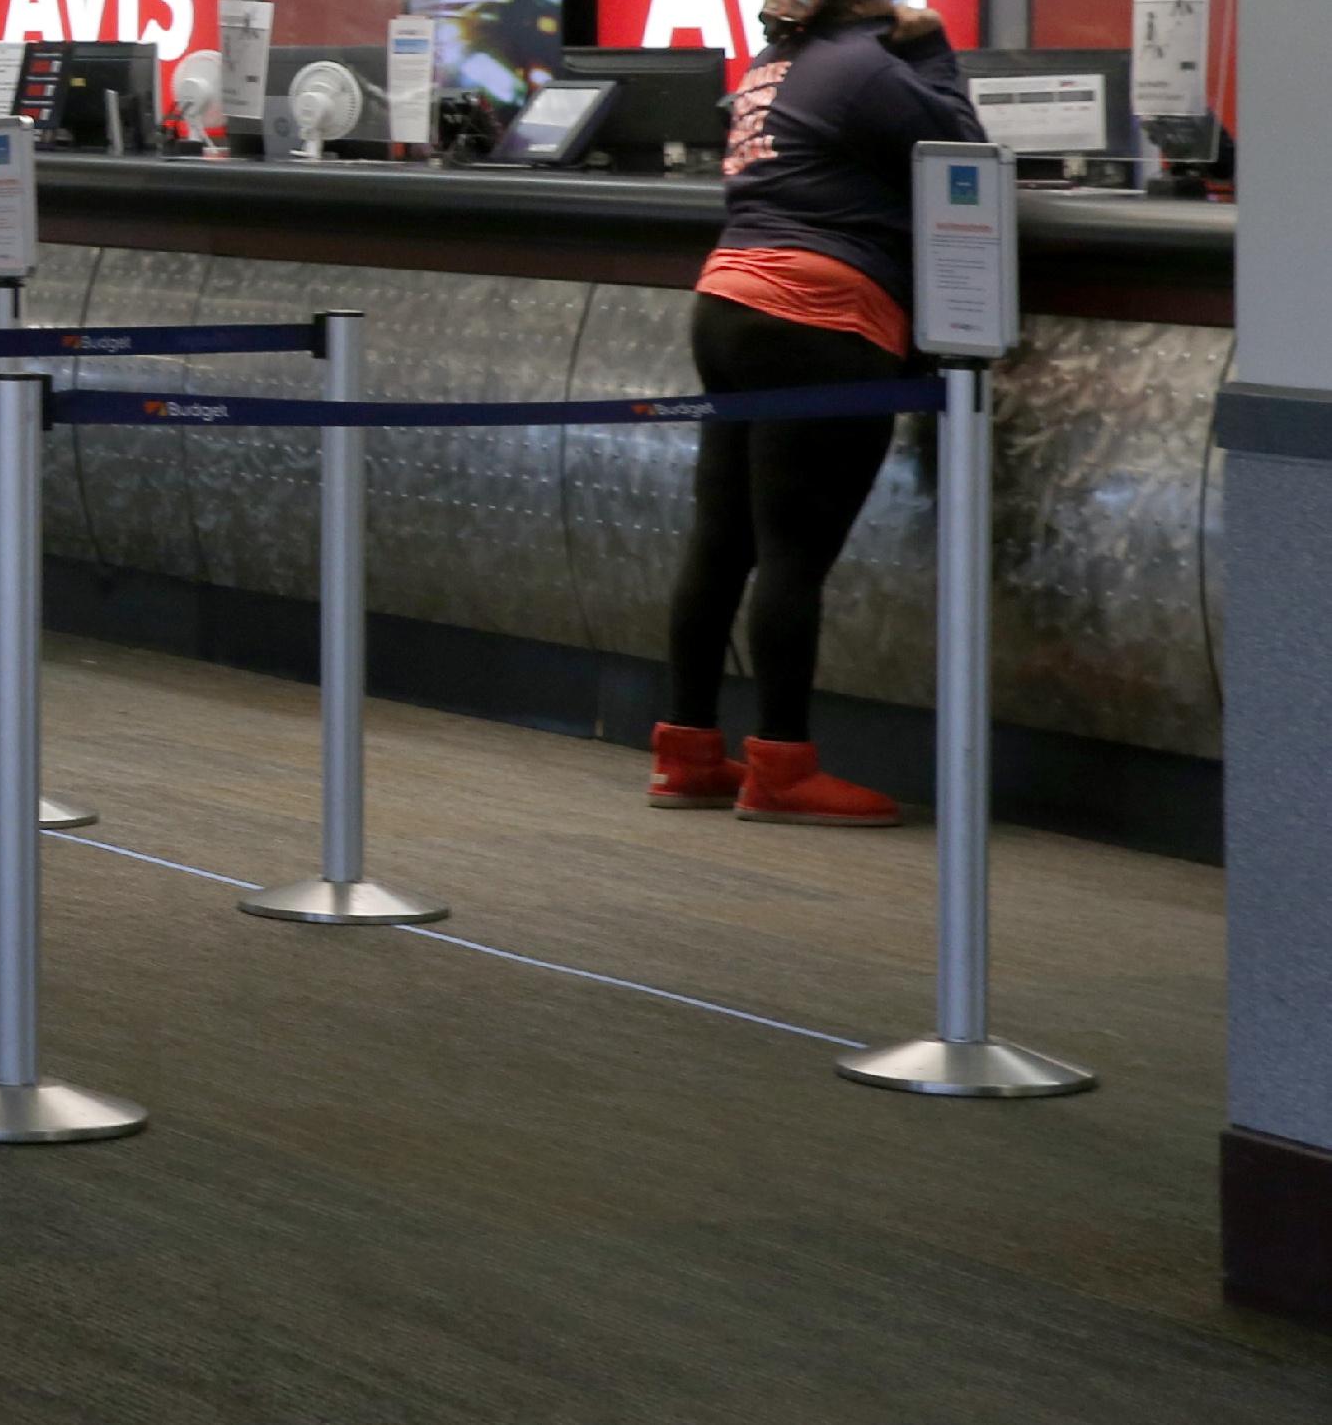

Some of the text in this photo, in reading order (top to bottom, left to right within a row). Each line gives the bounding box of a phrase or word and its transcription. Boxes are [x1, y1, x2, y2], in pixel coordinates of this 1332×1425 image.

[80, 336, 132, 352] Budget
[167, 402, 228, 422] Budget
[654, 393, 716, 417] Budget
